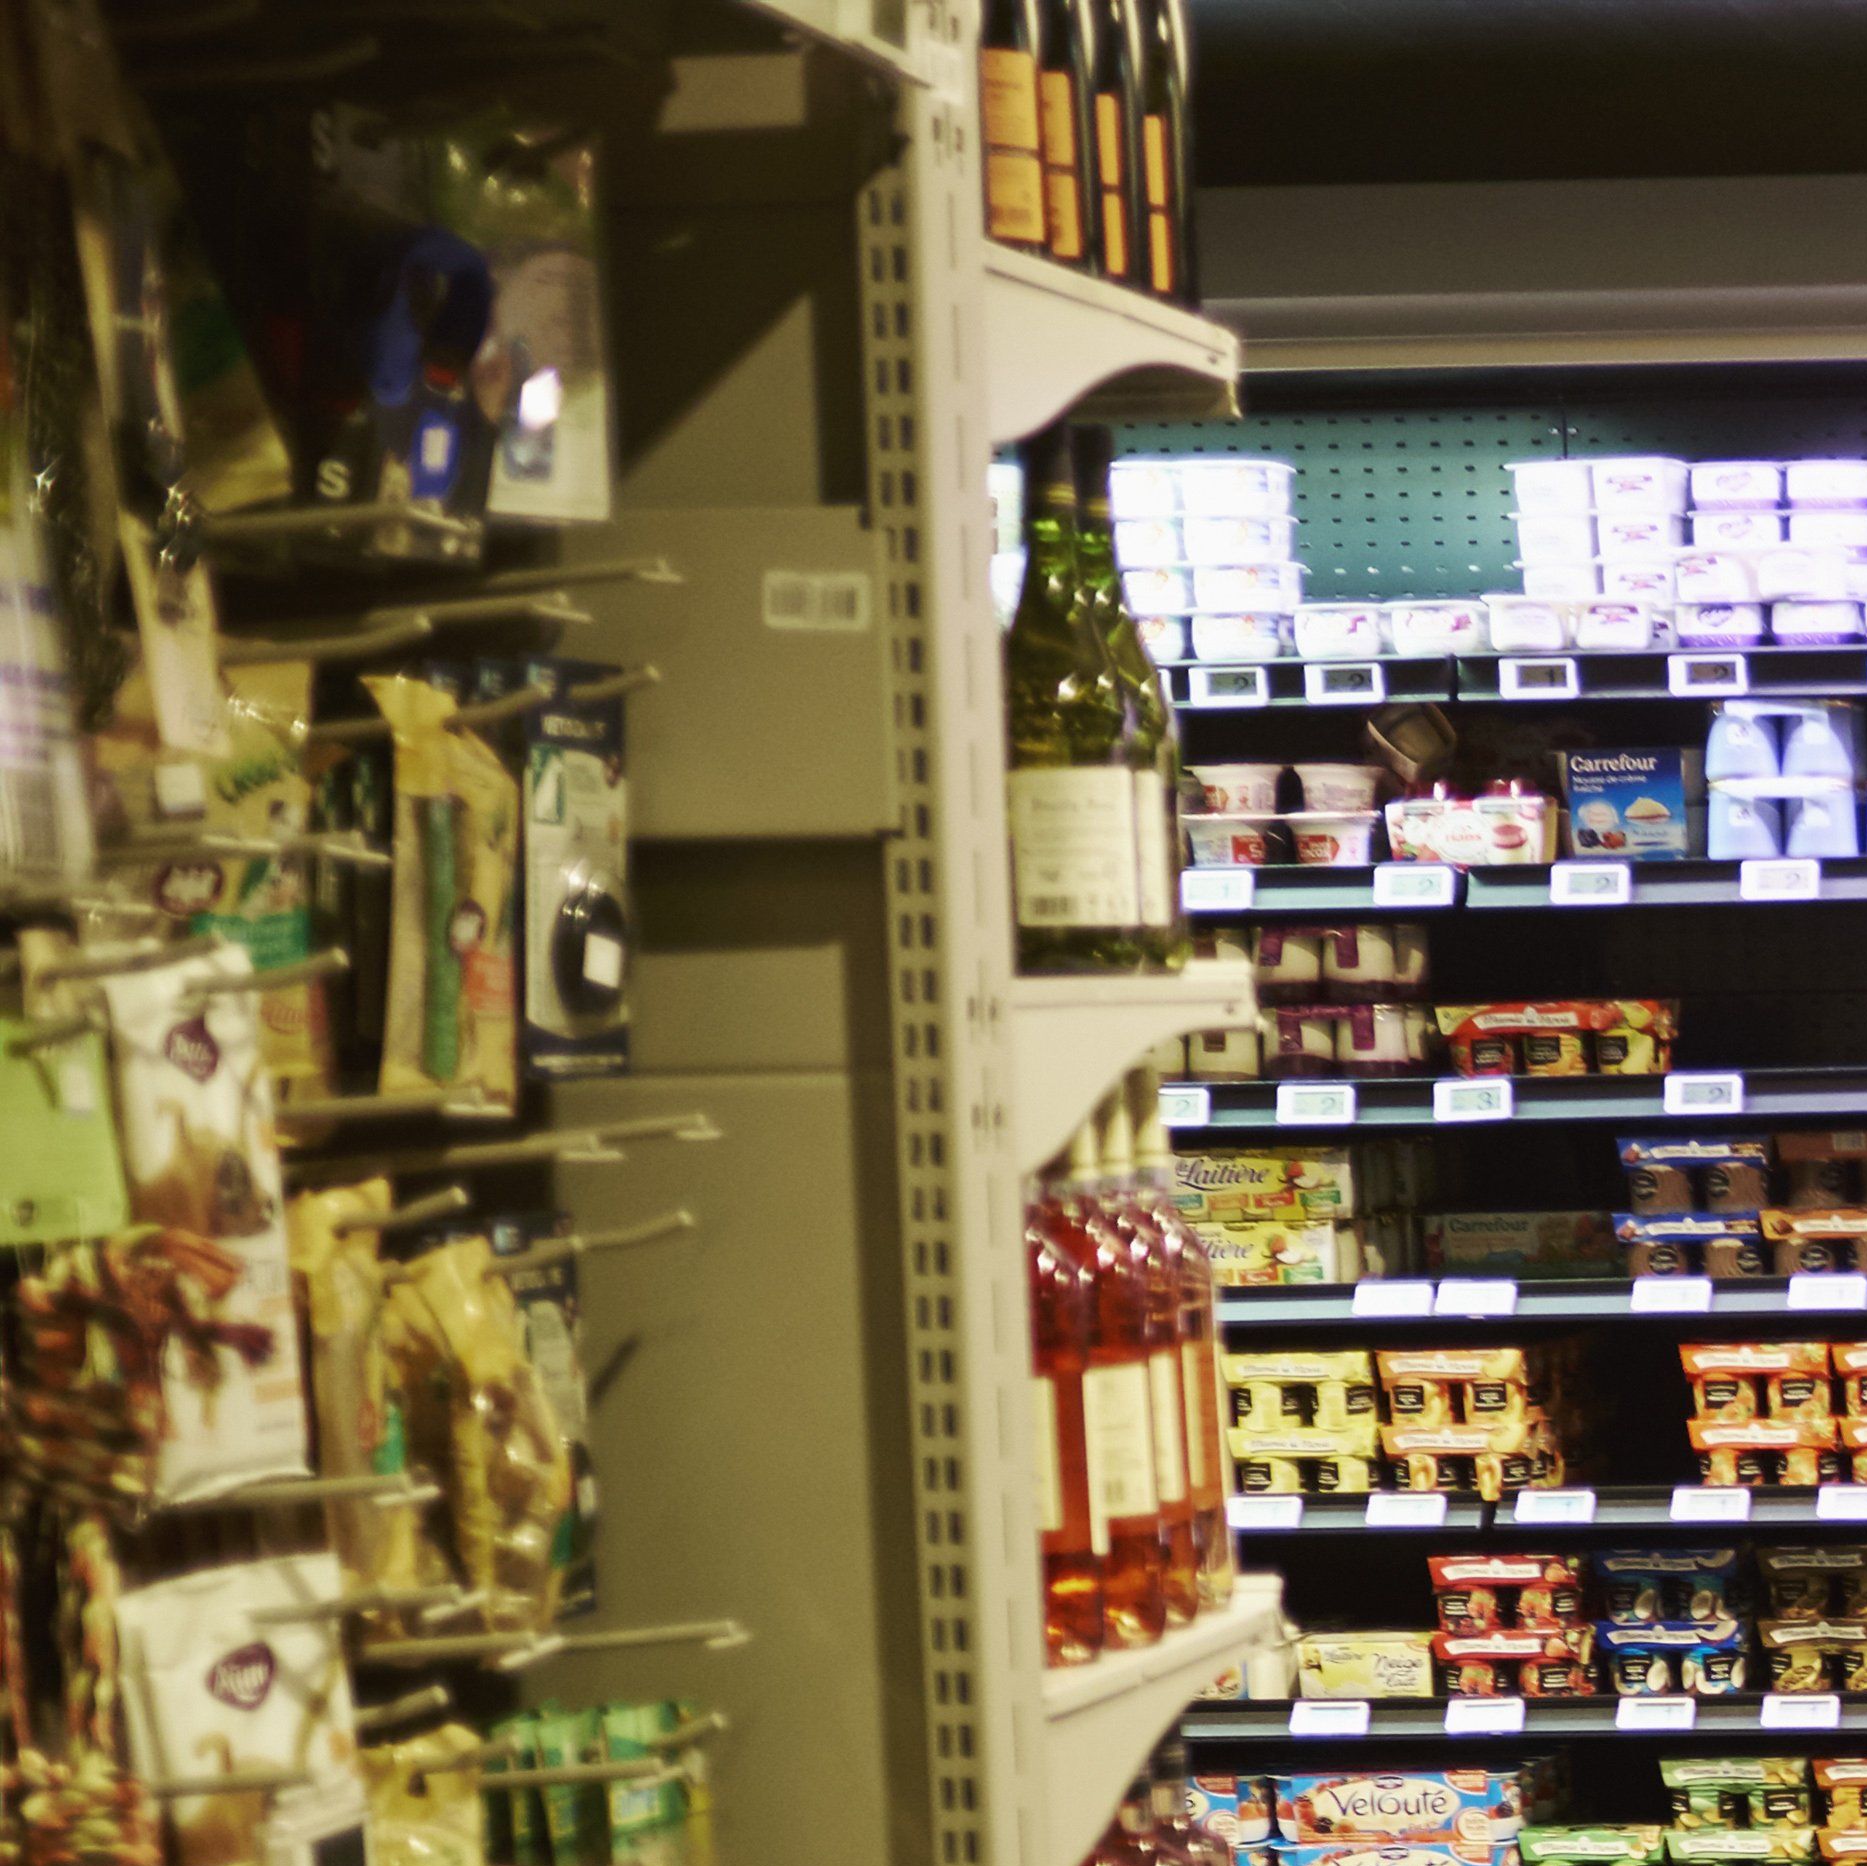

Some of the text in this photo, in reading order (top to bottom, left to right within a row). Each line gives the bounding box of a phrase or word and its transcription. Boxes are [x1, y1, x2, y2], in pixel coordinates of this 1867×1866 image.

[1570, 753, 1658, 772] Carrefour
[1179, 1160, 1271, 1191] Laitière
[1328, 1788, 1448, 1817] Velouté
